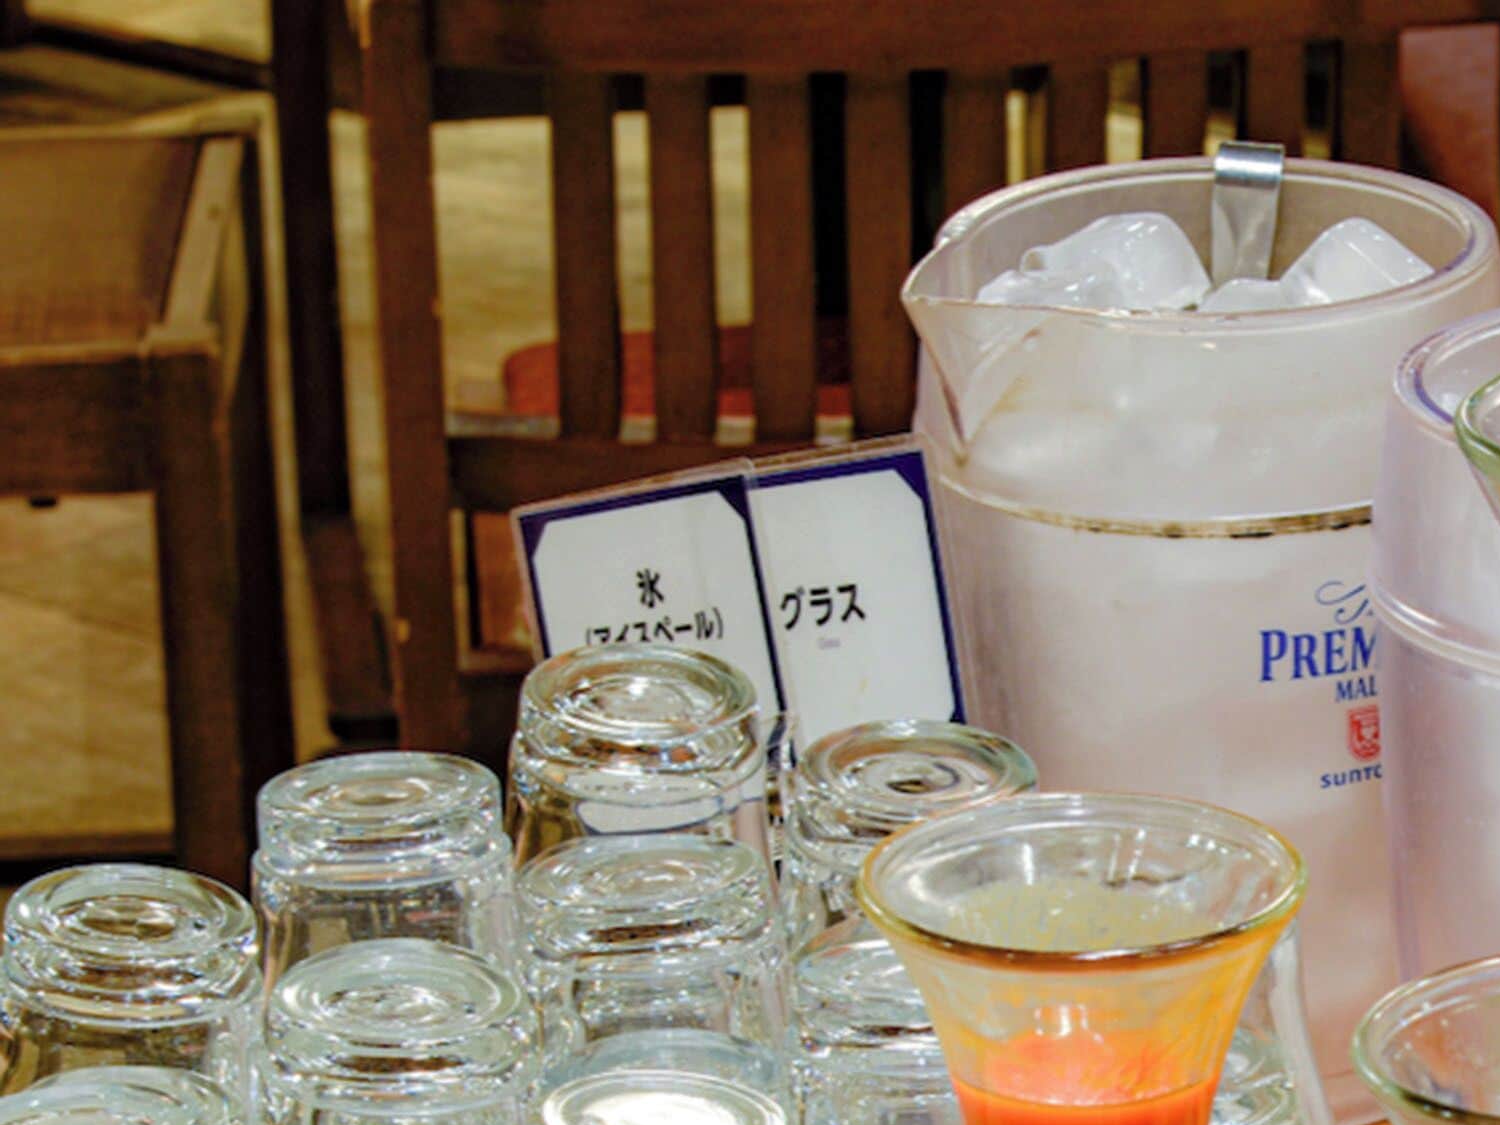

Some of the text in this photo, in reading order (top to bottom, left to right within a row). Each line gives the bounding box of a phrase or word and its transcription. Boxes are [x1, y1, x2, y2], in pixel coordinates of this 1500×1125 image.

[636, 568, 665, 608] 氷
[779, 583, 867, 631] グラス
